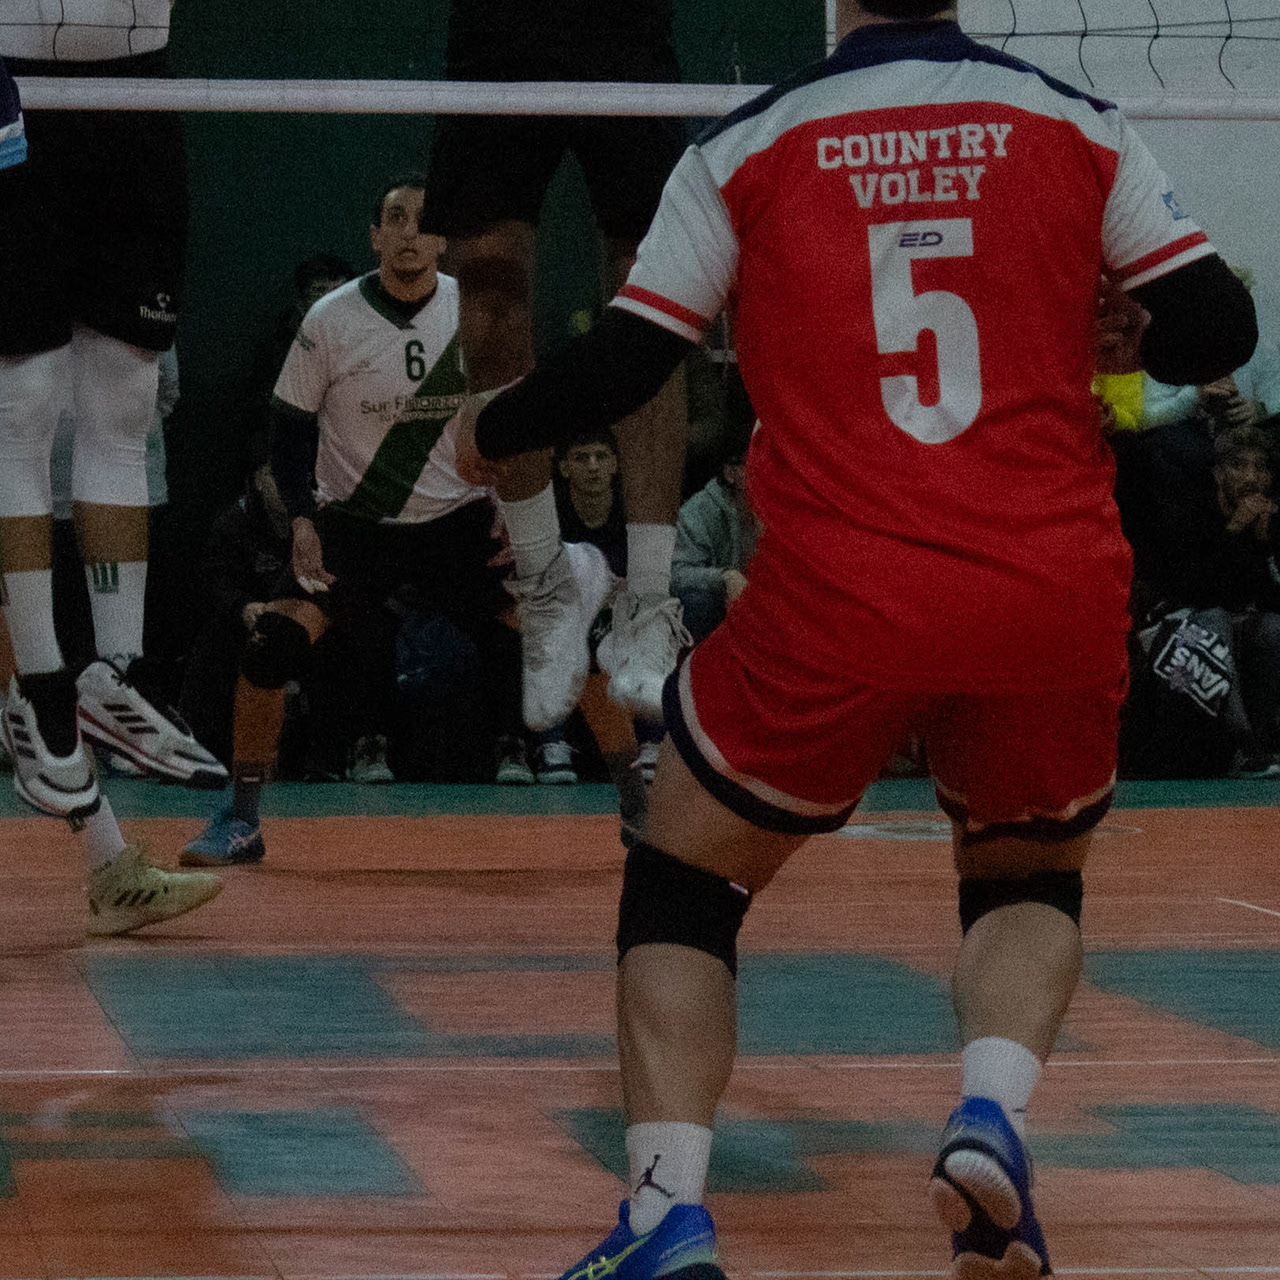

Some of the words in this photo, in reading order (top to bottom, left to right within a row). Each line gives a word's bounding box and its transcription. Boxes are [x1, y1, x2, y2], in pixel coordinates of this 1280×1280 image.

[817, 123, 1013, 169] COUNTRY
[849, 164, 986, 209] VOLEY
[868, 217, 983, 445] 5
[405, 340, 426, 381] 6
